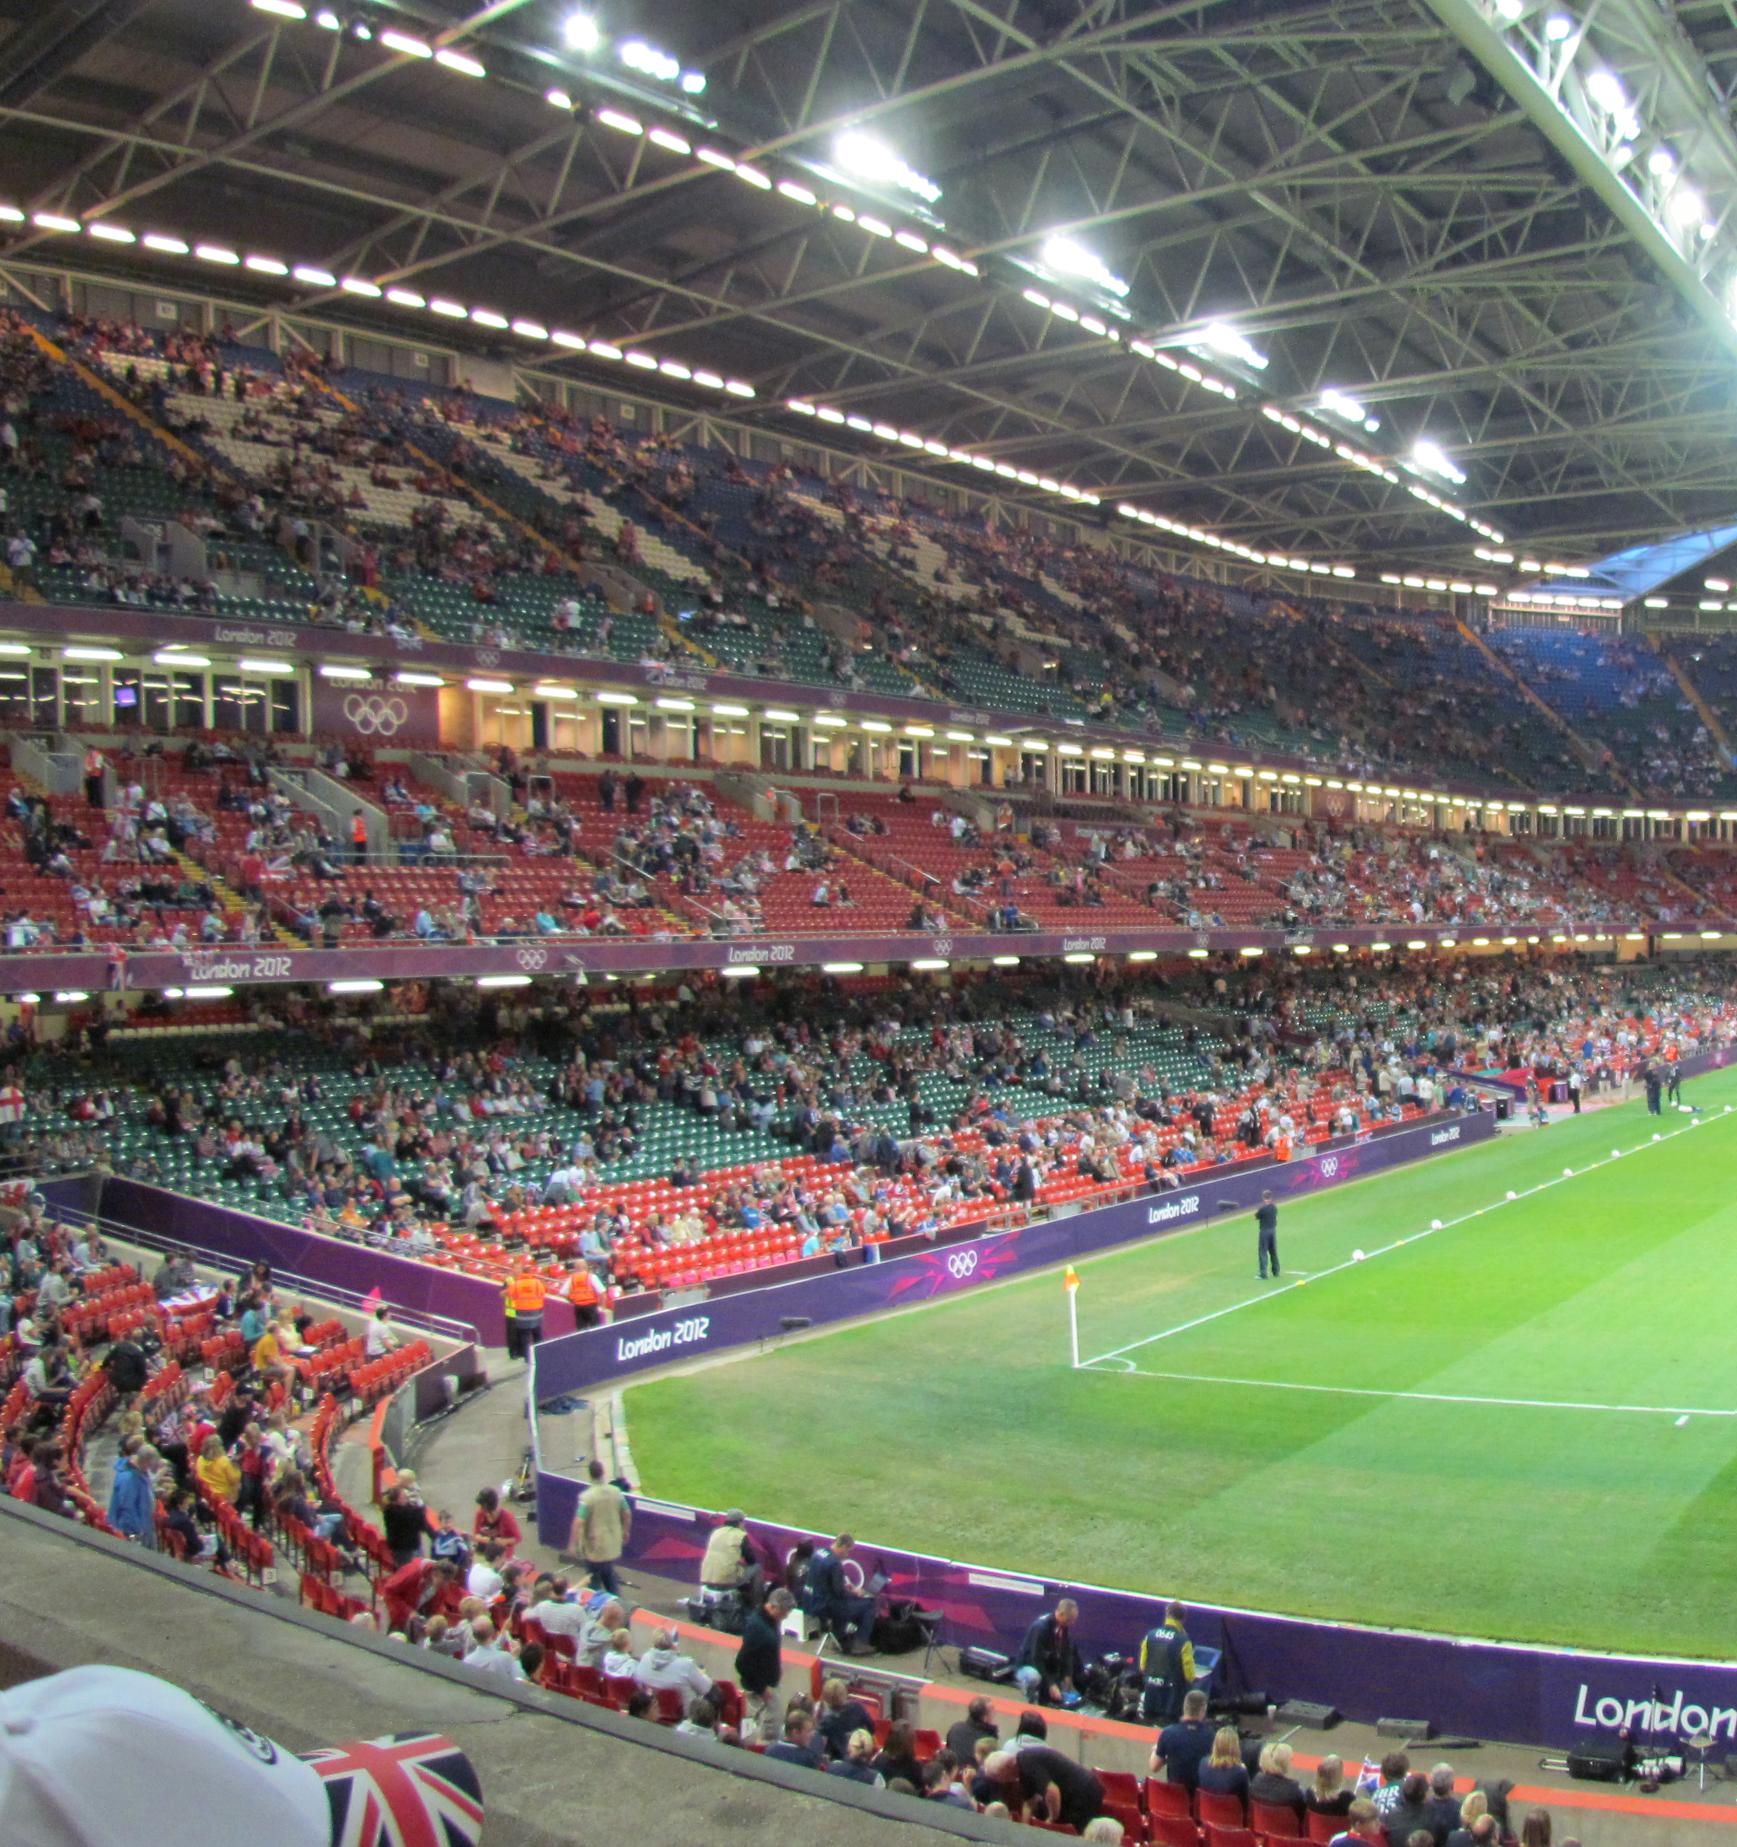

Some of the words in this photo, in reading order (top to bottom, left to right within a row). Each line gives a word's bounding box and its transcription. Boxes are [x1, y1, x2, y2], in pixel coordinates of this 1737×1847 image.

[729, 945, 769, 962] London
[770, 944, 795, 961] 2012
[253, 957, 292, 977] 2012
[1148, 1203, 1180, 1223] London
[1180, 1196, 1200, 1214] 2012
[617, 1328, 672, 1361] London
[673, 1317, 710, 1344] 2012
[1574, 1684, 1737, 1738] London
